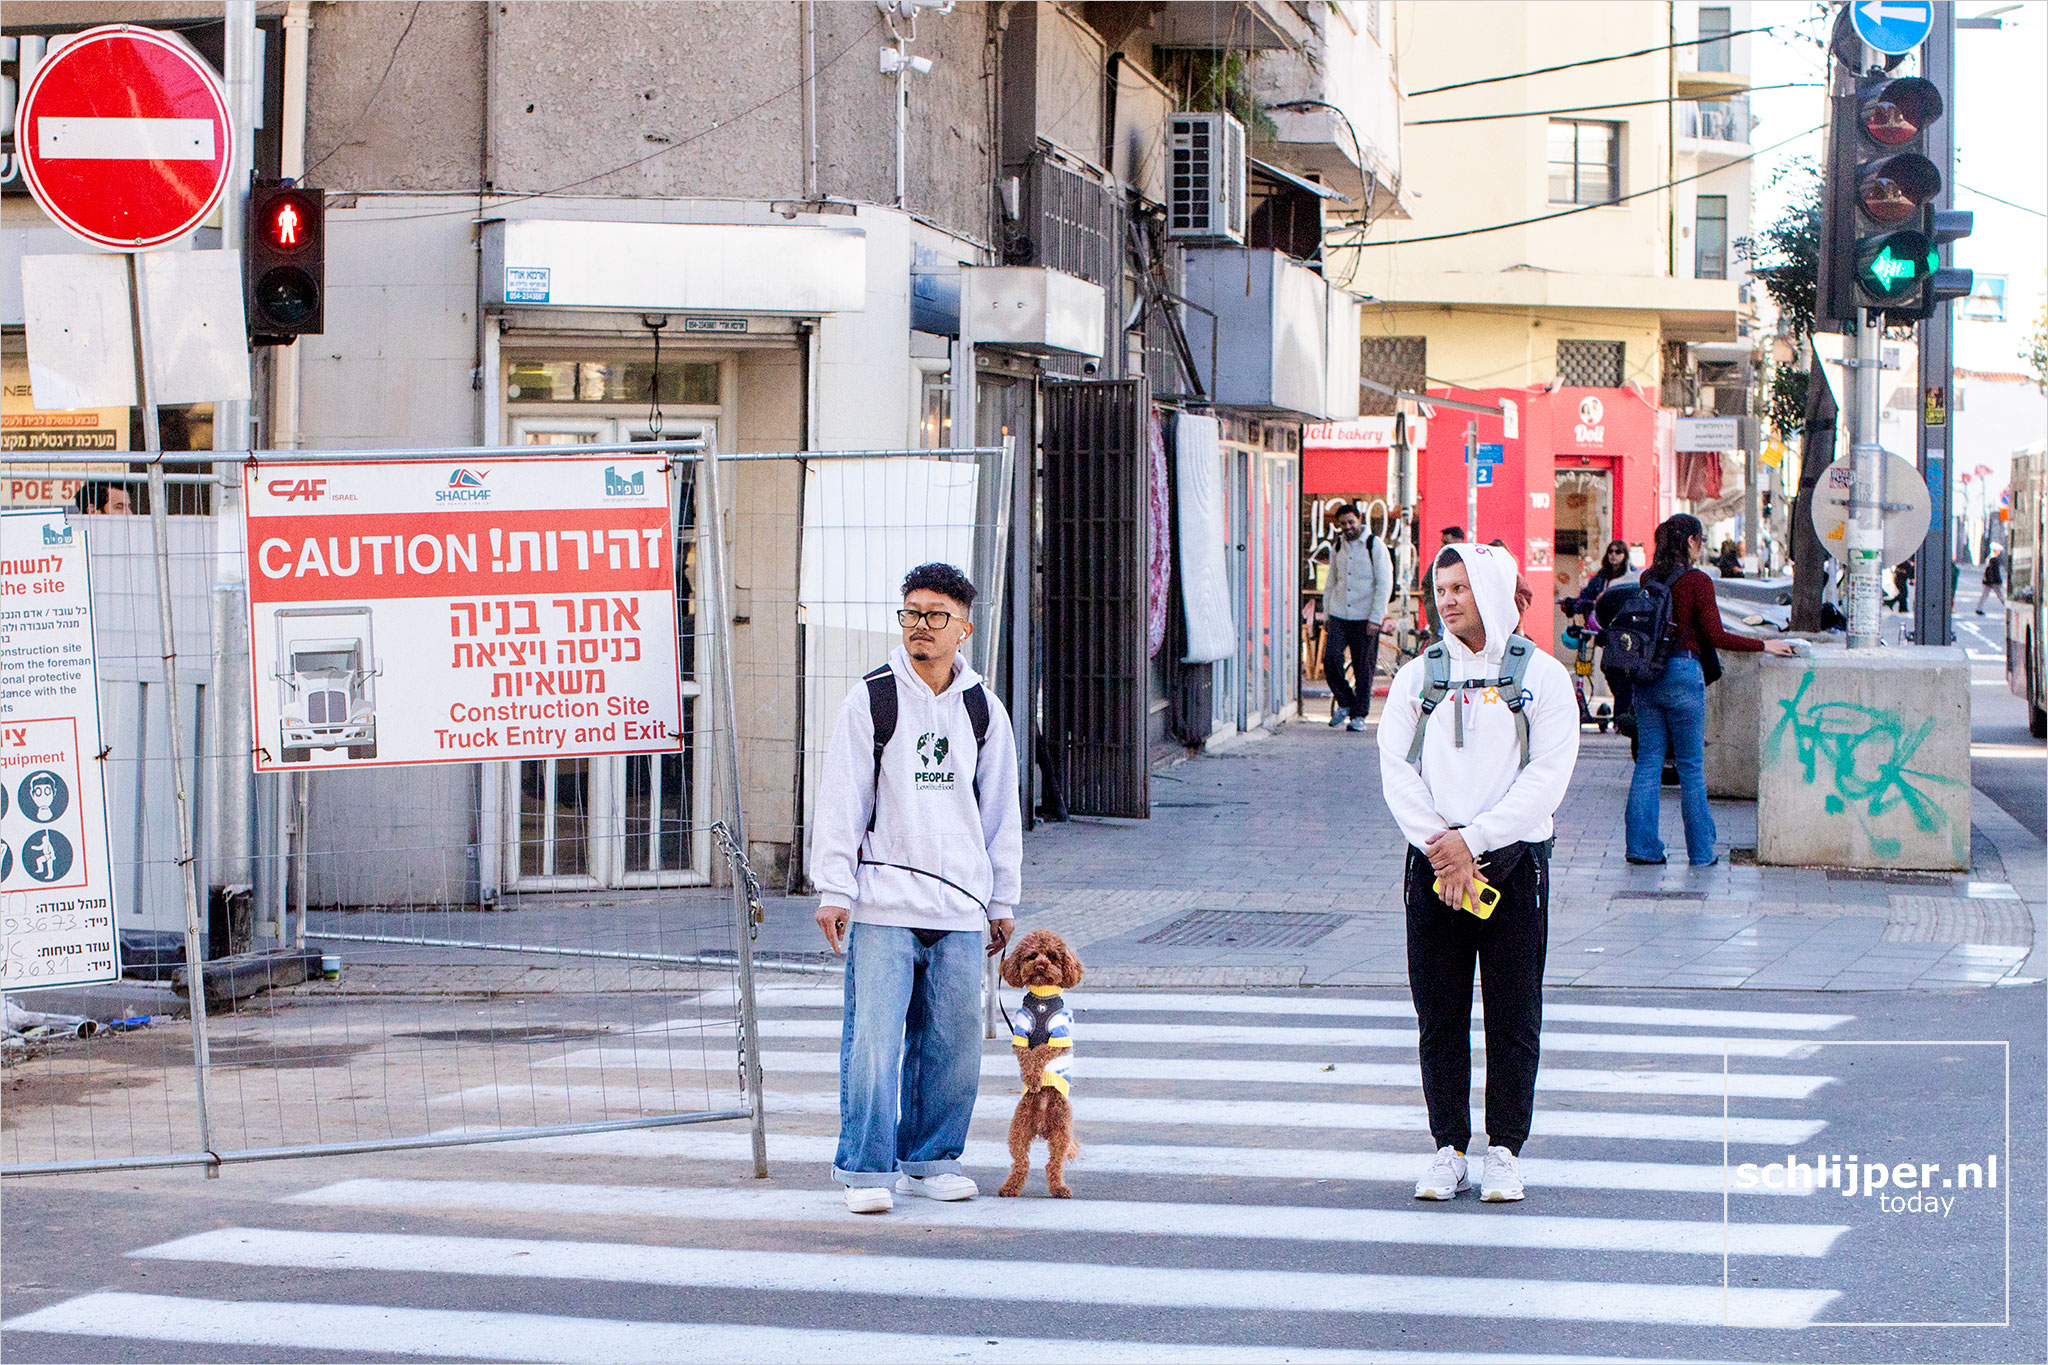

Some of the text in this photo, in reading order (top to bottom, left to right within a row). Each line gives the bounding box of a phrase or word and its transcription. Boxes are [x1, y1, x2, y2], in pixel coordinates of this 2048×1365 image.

[24, 415, 43, 425] לבית
[46, 416, 73, 425] מושלם
[75, 416, 97, 425] מבצע
[1337, 428, 1383, 445] bakery
[1574, 424, 1605, 443] Doli
[29, 432, 74, 448] דיגטלית
[76, 434, 115, 447] מערכת
[1478, 469, 1487, 482] 2
[12, 480, 53, 500] POE
[267, 479, 327, 501] CAF
[435, 489, 491, 501] SHACHAF
[608, 484, 643, 495] שפיר
[332, 493, 359, 501] ISRAEL
[44, 535, 73, 545] שפיר
[258, 533, 477, 580] CAUTION
[490, 527, 664, 574] זהירות!
[1, 578, 65, 596] the site
[24, 609, 43, 618] אדם
[52, 607, 74, 617] עובד
[76, 606, 88, 617] כל
[450, 596, 641, 637] אתר בניה
[20, 621, 54, 632] העבודה
[56, 619, 80, 629] מנהל
[63, 643, 82, 653] site
[452, 637, 641, 668] כניסה ויציאת
[28, 660, 45, 669] the
[47, 657, 91, 668] foreman
[28, 671, 82, 685] protective
[491, 669, 605, 699] משאיות
[35, 687, 57, 697] with
[60, 685, 77, 695] the
[450, 695, 650, 724] Construction Site
[434, 720, 667, 753] Truck Entry and Exit
[914, 772, 955, 783] PEOPLE
[36, 900, 75, 914] עבודה:
[77, 898, 107, 910] מנהל
[84, 917, 108, 928] נייד:
[37, 944, 83, 957] בטיחות:
[85, 942, 110, 952] עוזר
[87, 960, 112, 971] נייד:
